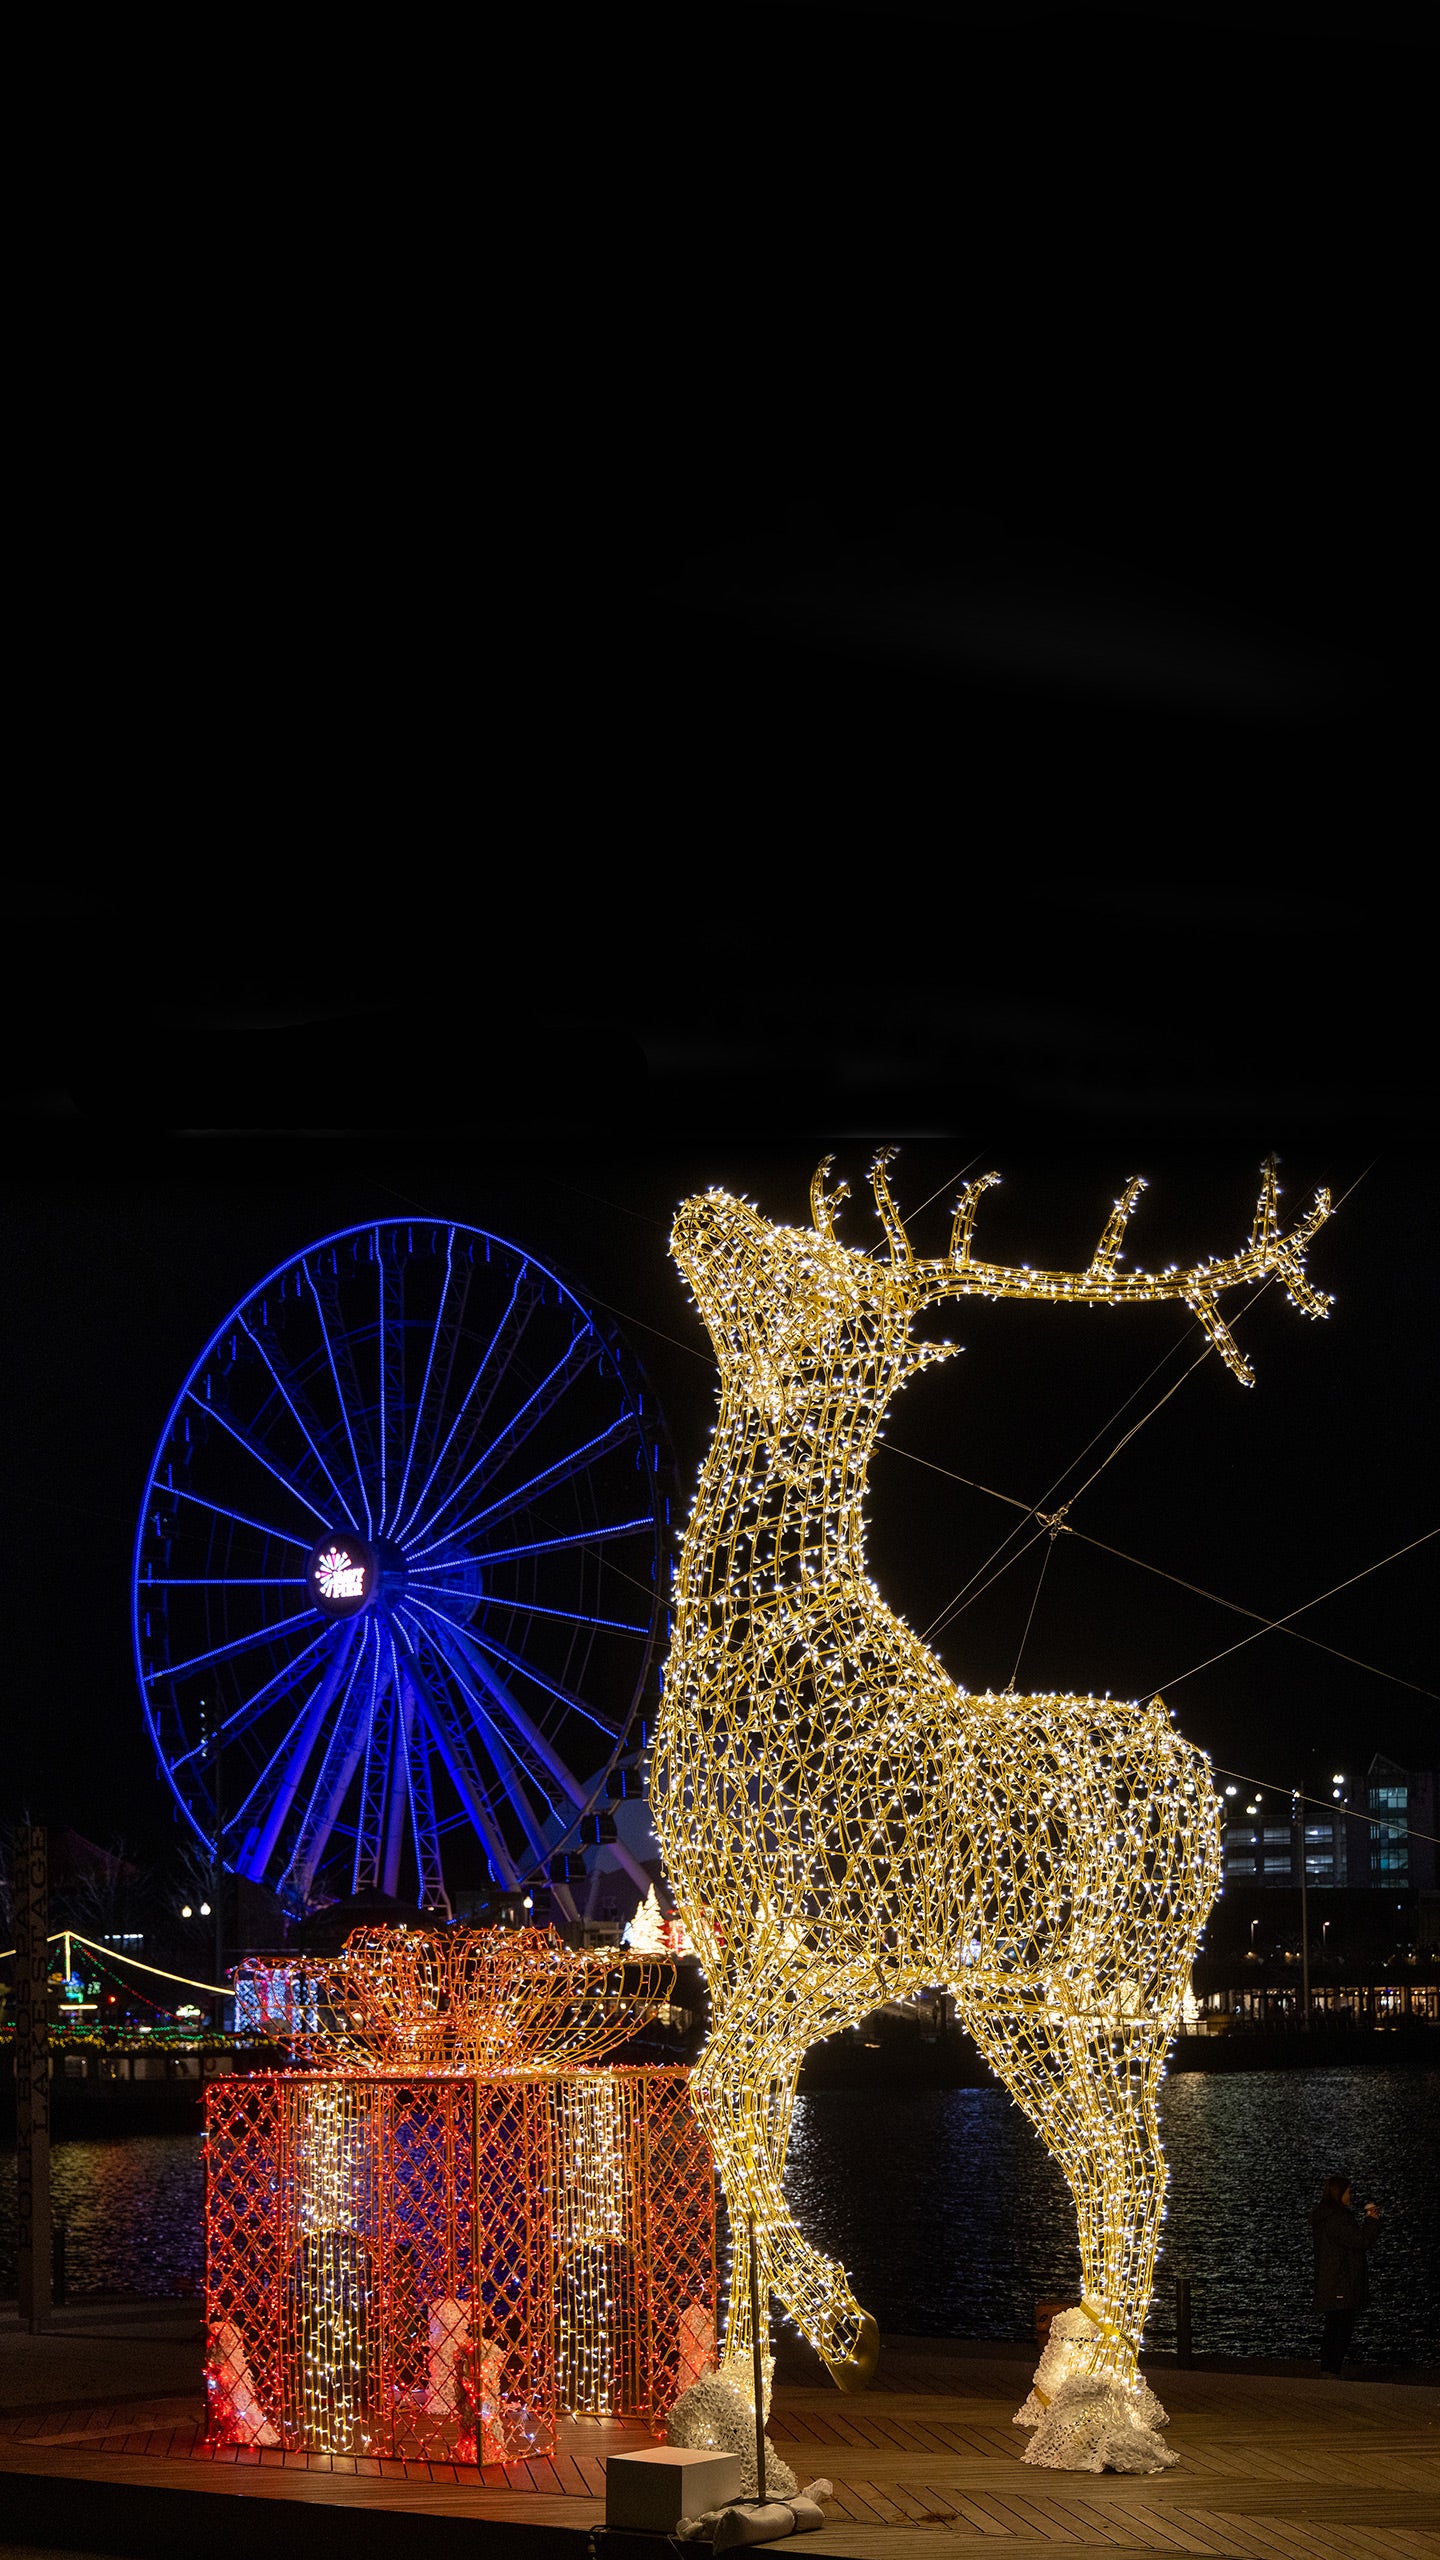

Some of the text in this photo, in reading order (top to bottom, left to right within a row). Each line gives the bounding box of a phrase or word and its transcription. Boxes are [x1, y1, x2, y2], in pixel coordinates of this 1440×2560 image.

[16, 1826, 33, 2249] POLK BROS PARK
[31, 1825, 48, 2133] LAKE STAGE
